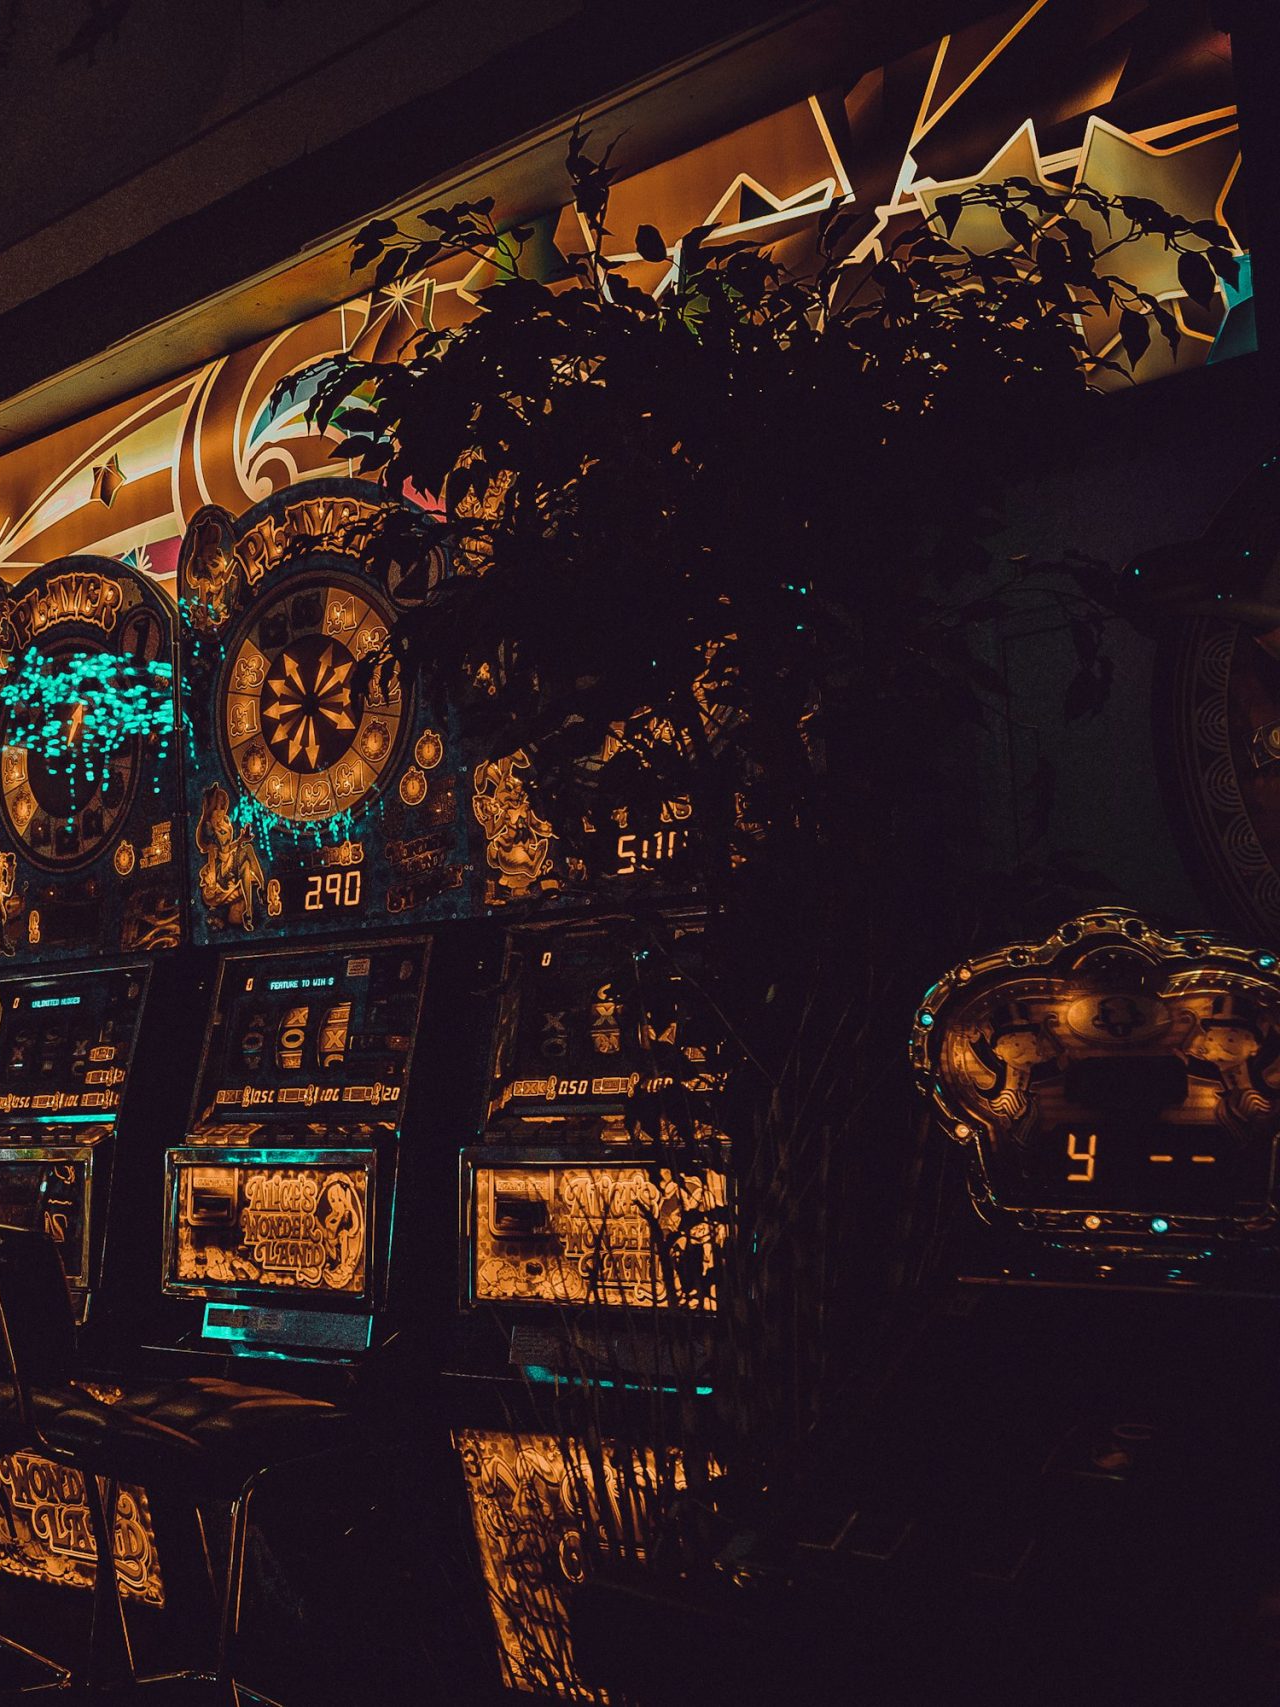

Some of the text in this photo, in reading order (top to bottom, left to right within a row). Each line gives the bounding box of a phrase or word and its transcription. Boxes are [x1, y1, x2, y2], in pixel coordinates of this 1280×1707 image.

[302, 979, 310, 987] TO
[312, 978, 326, 986] WIN
[245, 1174, 318, 1212] ALICE'S
[240, 1212, 320, 1243] WONDER
[254, 1241, 326, 1276] LAND
